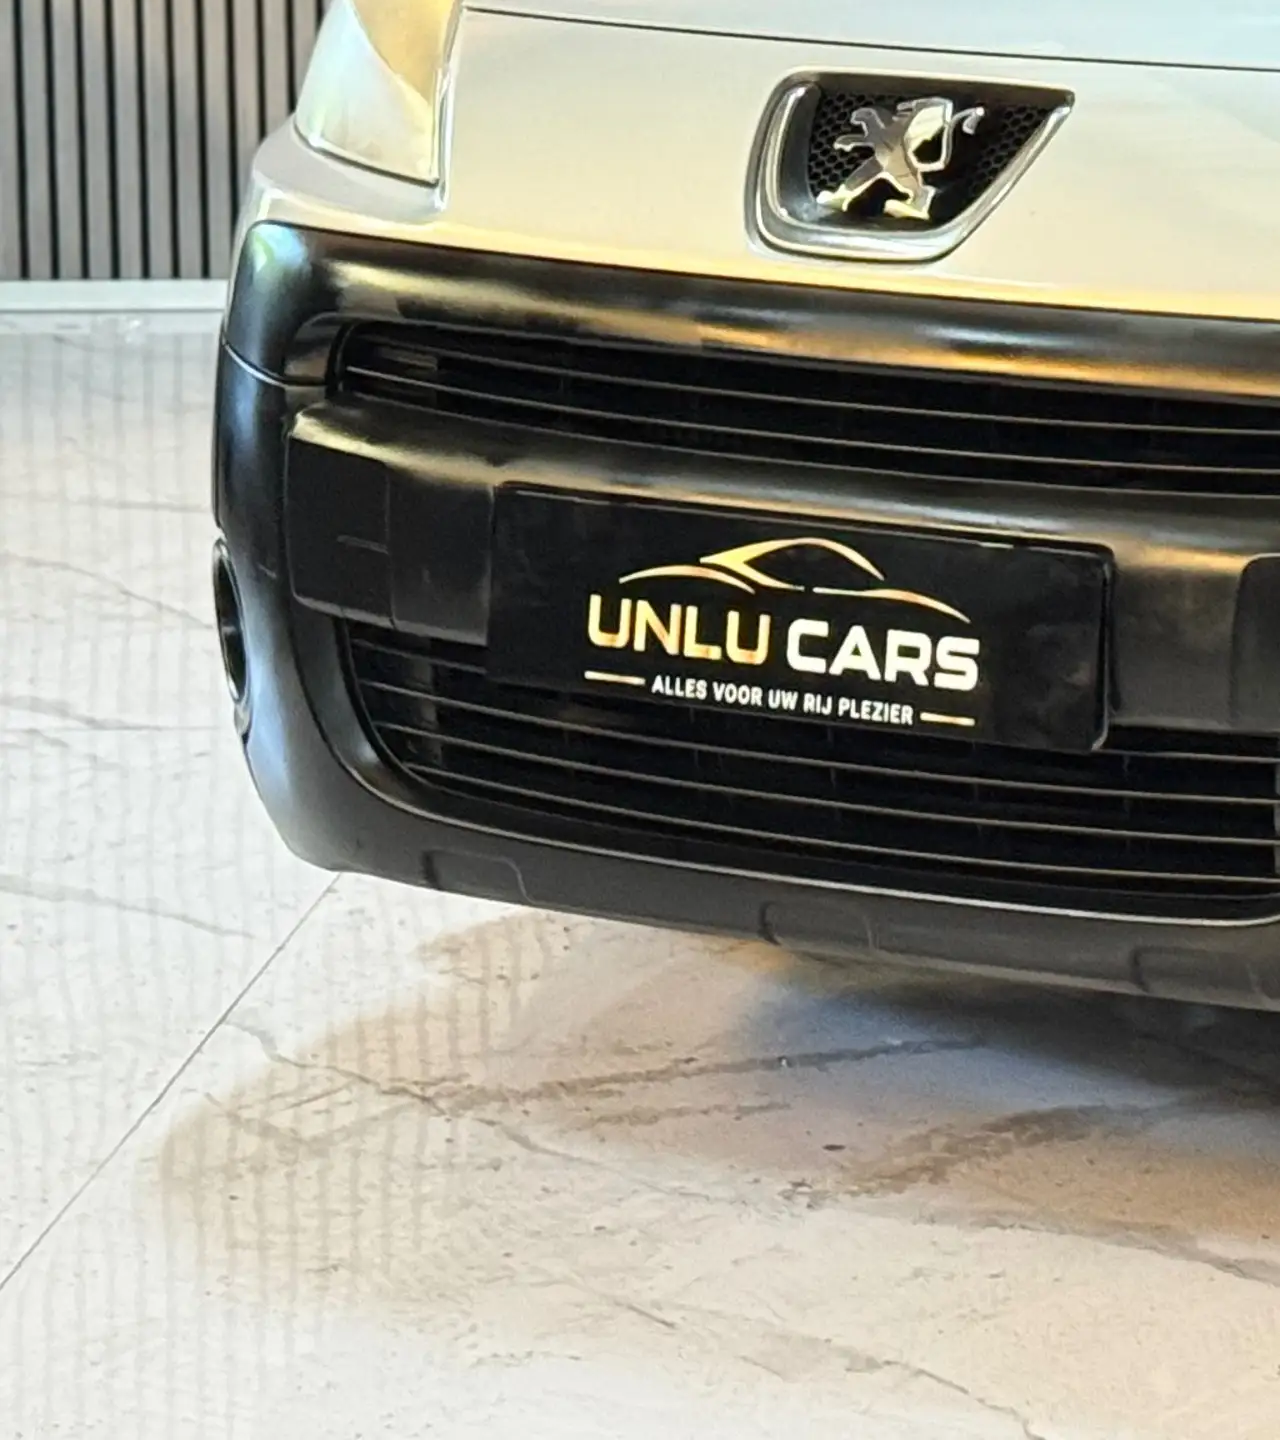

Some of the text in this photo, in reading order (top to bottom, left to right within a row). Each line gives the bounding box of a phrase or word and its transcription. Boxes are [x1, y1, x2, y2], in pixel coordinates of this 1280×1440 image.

[588, 594, 980, 691] UNLU CARS
[651, 674, 914, 726] ALLES VOOR UW RIJ PLEZIER
